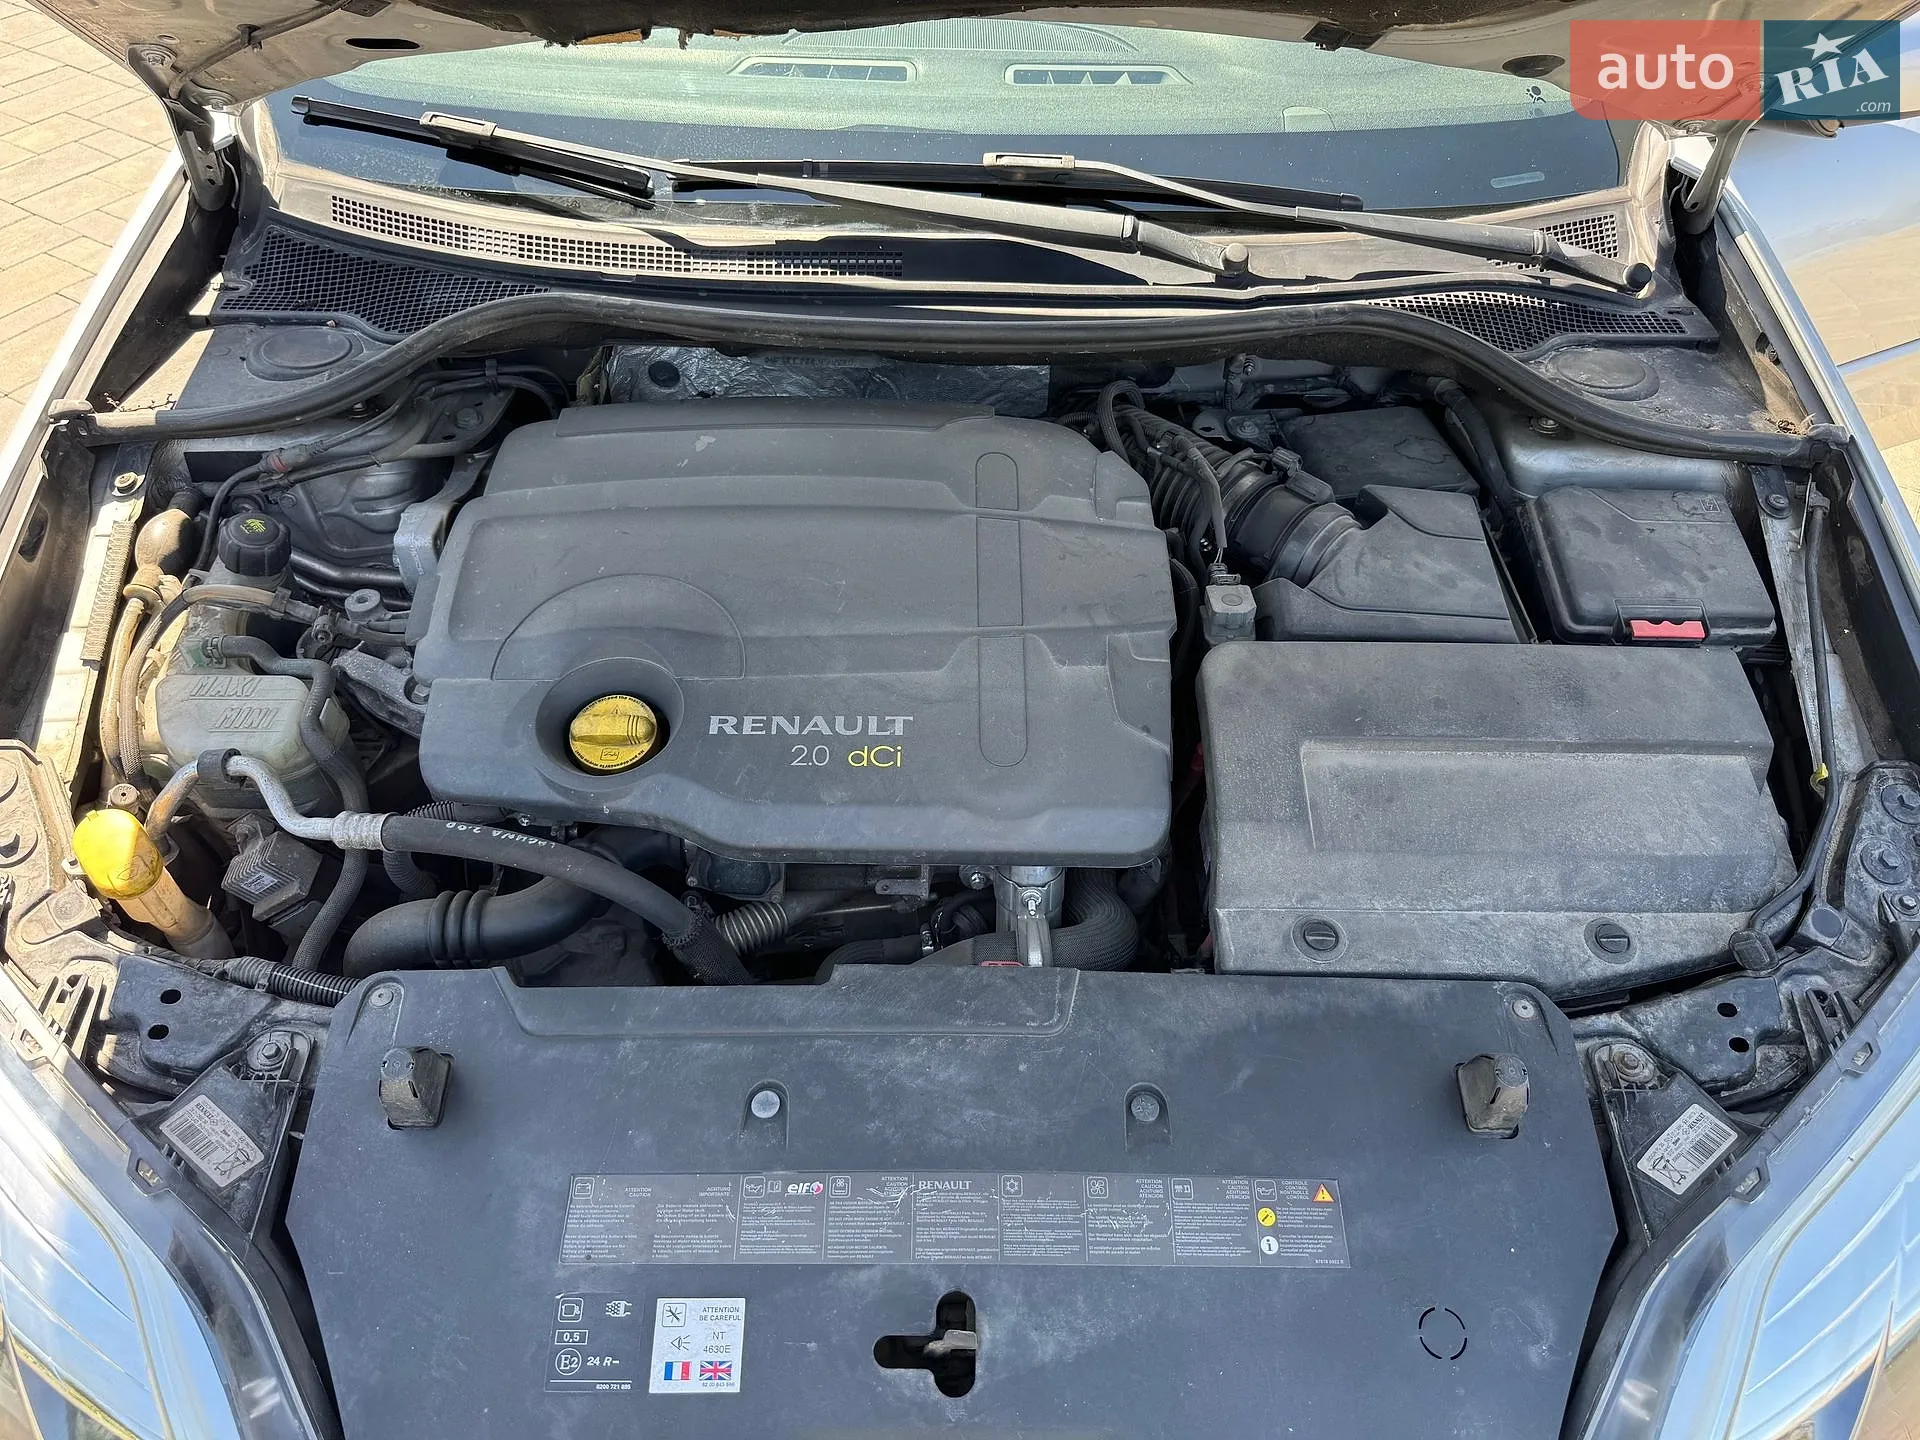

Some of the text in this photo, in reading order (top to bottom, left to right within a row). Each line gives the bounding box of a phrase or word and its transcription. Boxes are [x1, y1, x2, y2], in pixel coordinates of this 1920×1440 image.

[189, 676, 261, 698] MAXI
[214, 706, 279, 729] MINI
[708, 715, 914, 736] RENAULT
[790, 744, 903, 768] 2.0 dCi
[787, 1182, 811, 1194] elf
[918, 1180, 973, 1190] RENAULT
[563, 1332, 580, 1342] 0,5
[712, 1331, 726, 1340] NT
[703, 1345, 731, 1353] 4630E
[559, 1354, 578, 1370] E2
[586, 1356, 600, 1366] 24
